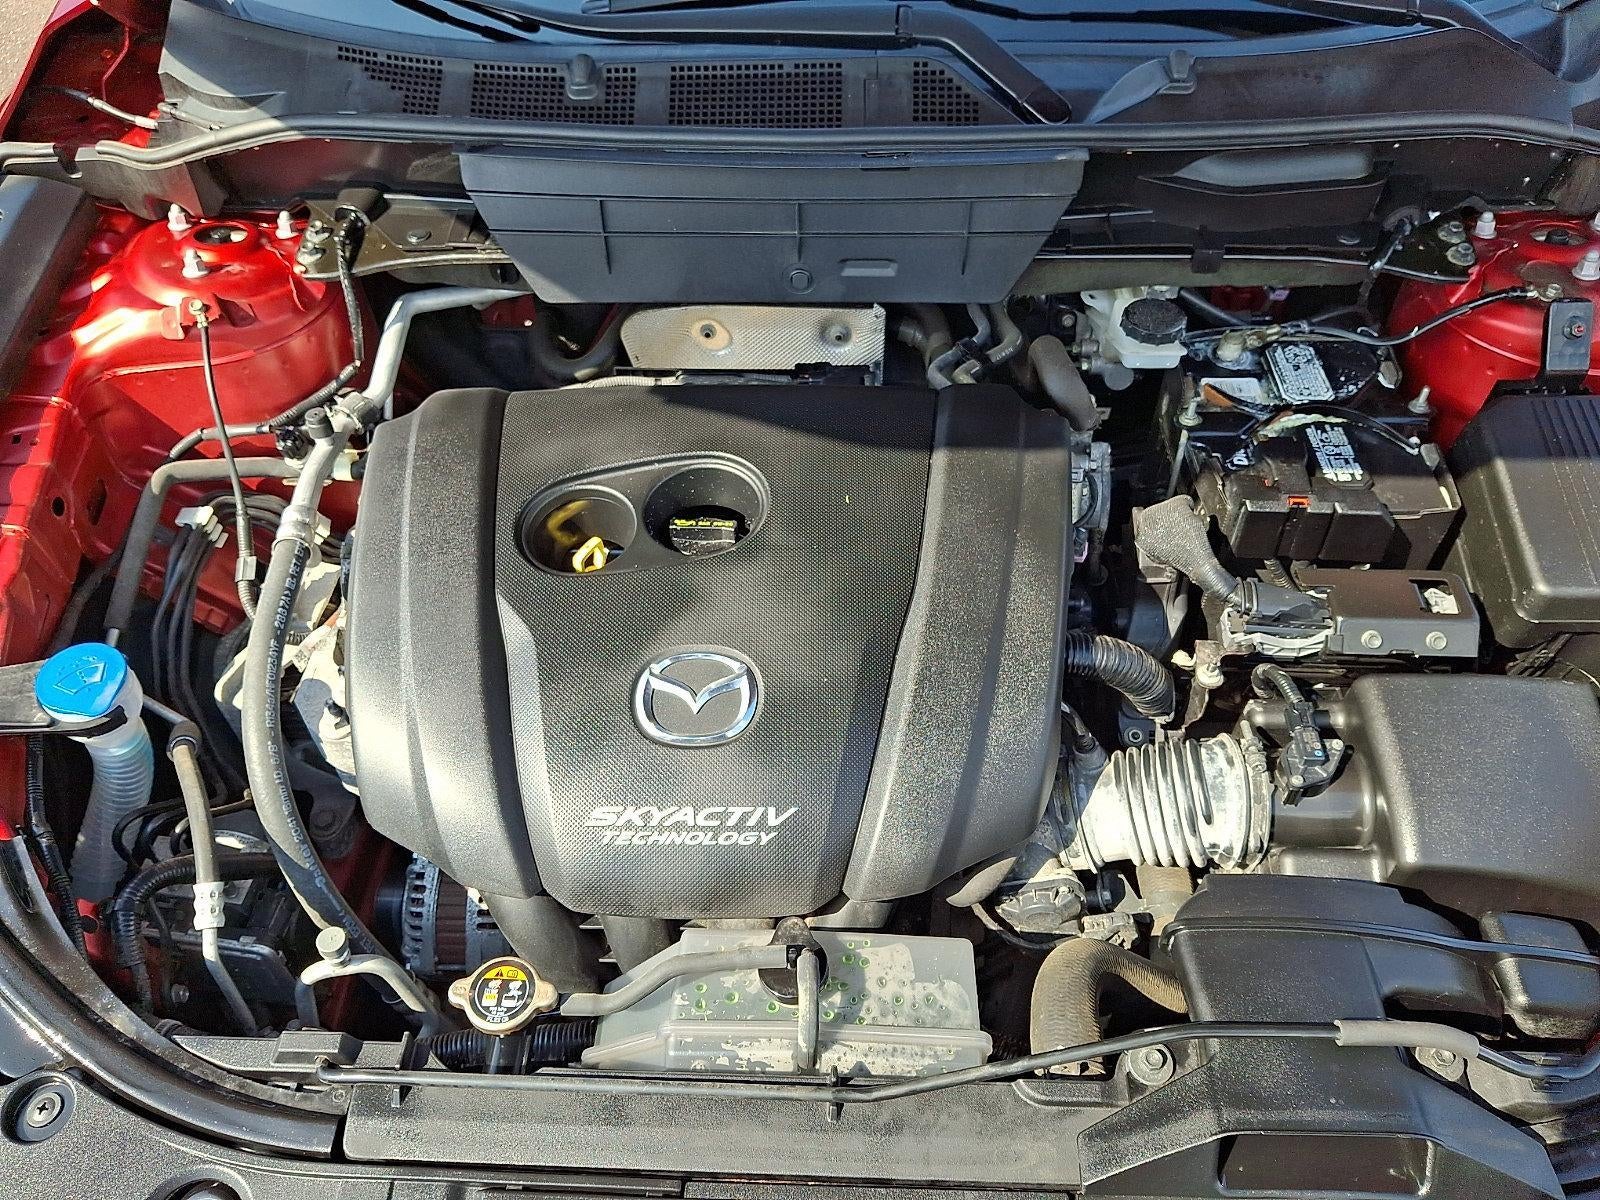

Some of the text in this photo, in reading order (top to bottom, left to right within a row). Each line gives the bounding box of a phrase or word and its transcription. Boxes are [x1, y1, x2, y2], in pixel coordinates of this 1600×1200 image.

[585, 806, 801, 827] SKYACTIV
[287, 816, 304, 843] 2041
[600, 831, 780, 845] TECHNOLOGY
